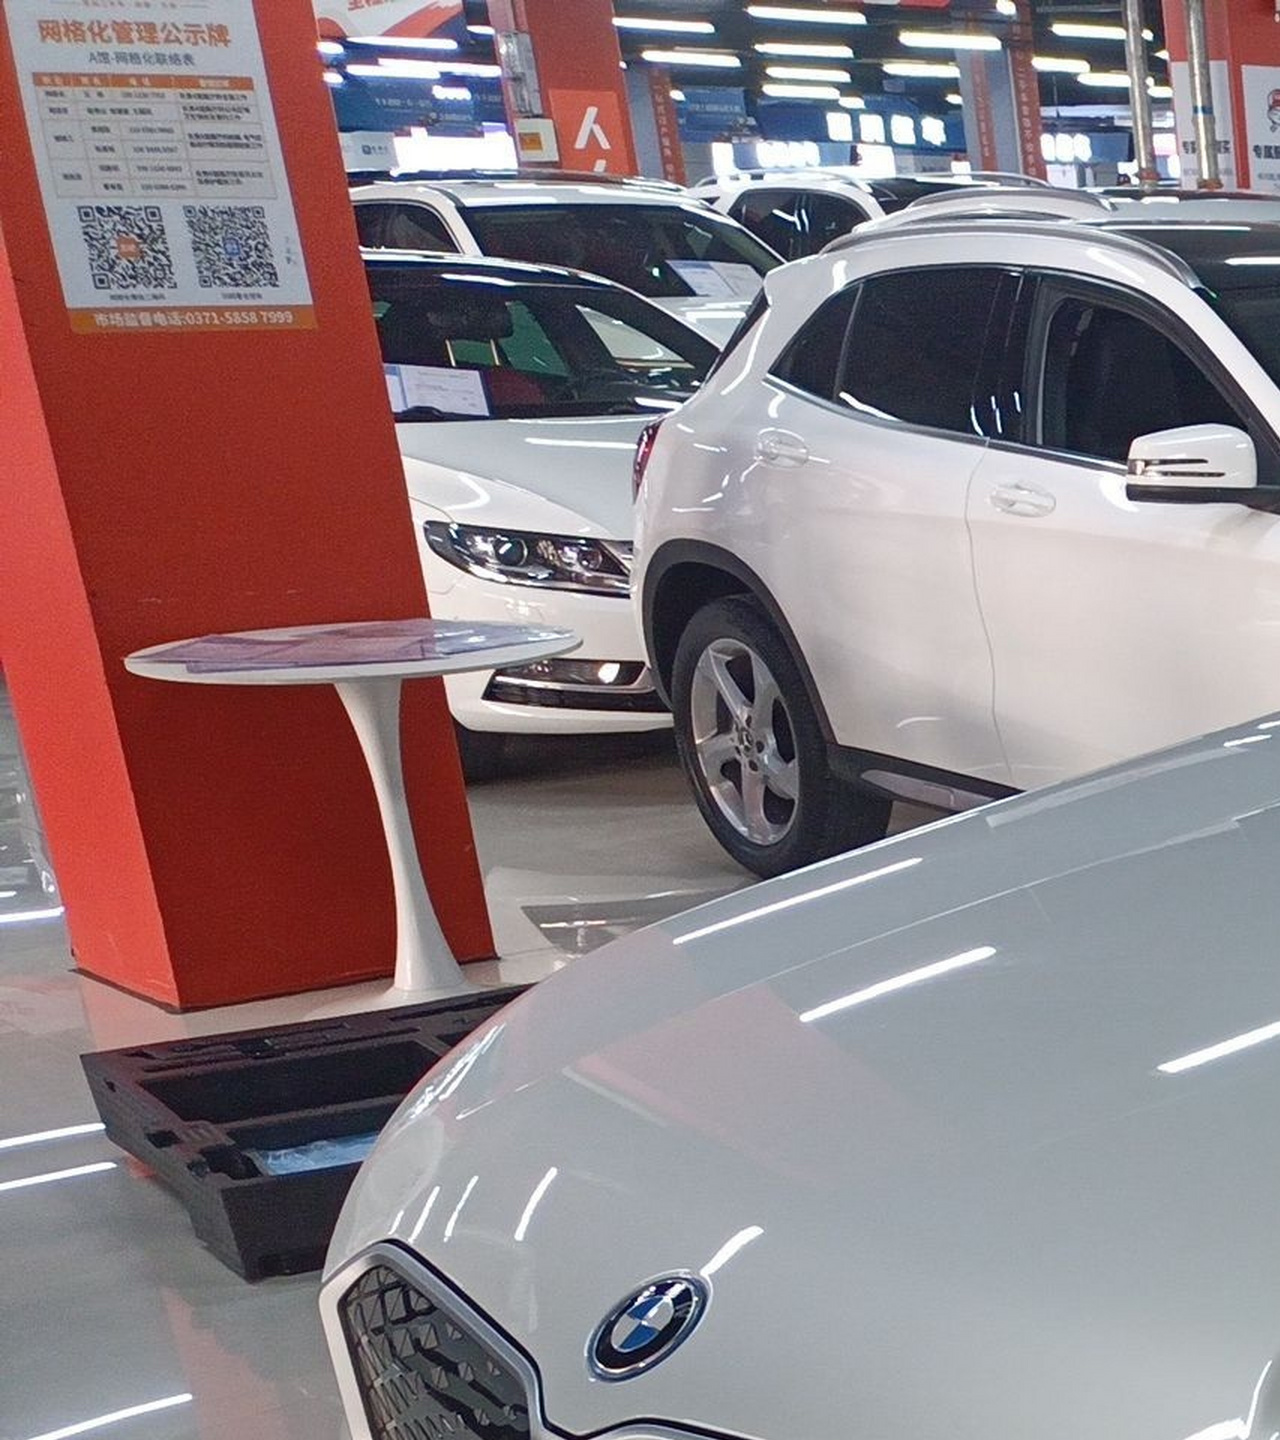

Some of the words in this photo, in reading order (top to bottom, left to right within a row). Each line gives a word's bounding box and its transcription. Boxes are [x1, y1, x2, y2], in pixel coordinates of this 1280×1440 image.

[37, 19, 231, 47] 网格化管理公示牌
